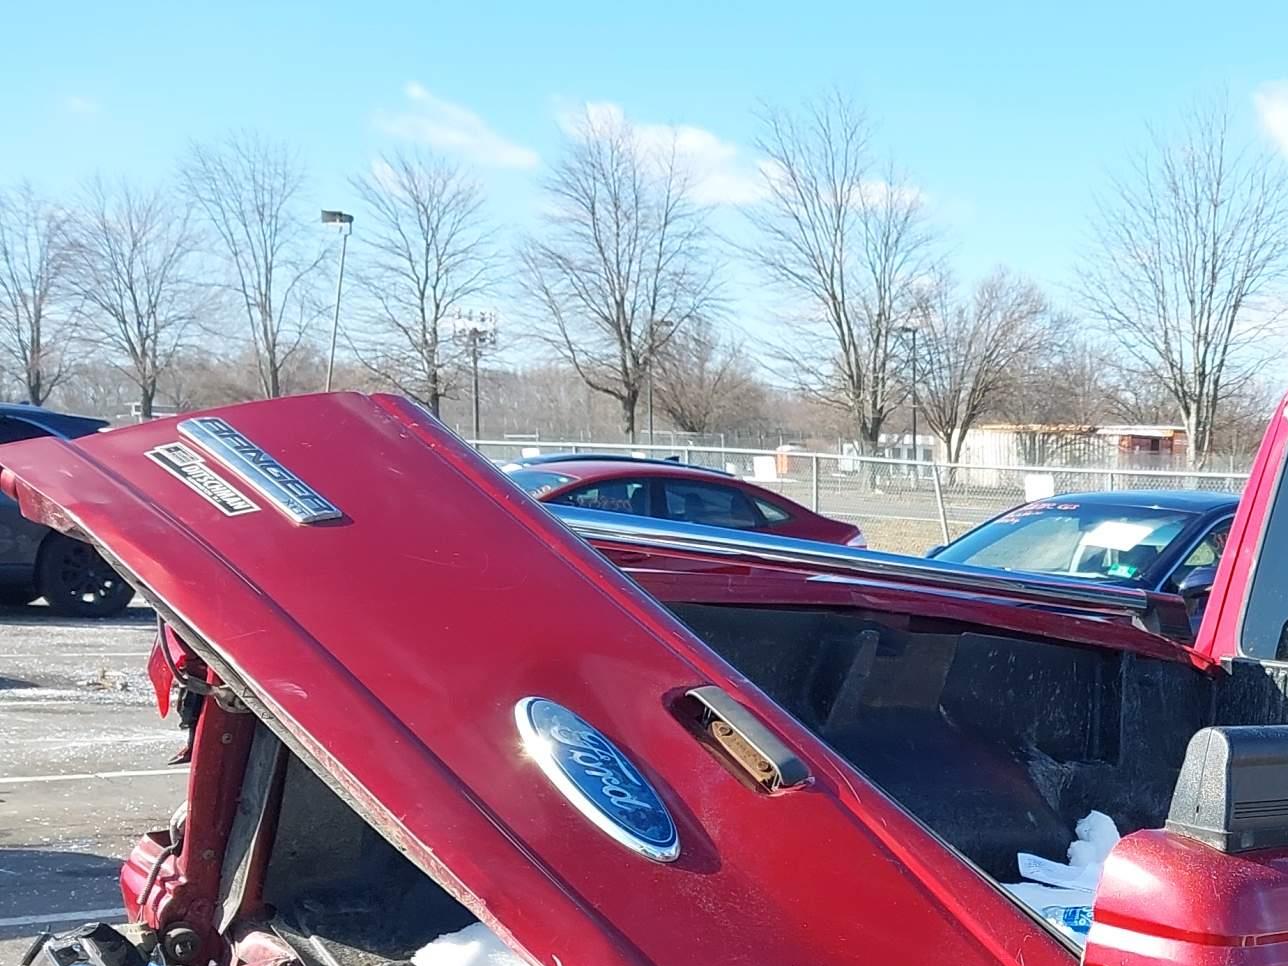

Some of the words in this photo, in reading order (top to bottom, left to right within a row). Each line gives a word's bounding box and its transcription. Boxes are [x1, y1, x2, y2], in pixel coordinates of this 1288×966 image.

[181, 463, 250, 511] DITSCHMAN
[199, 418, 337, 514] RANGER
[551, 724, 652, 811] Ford
